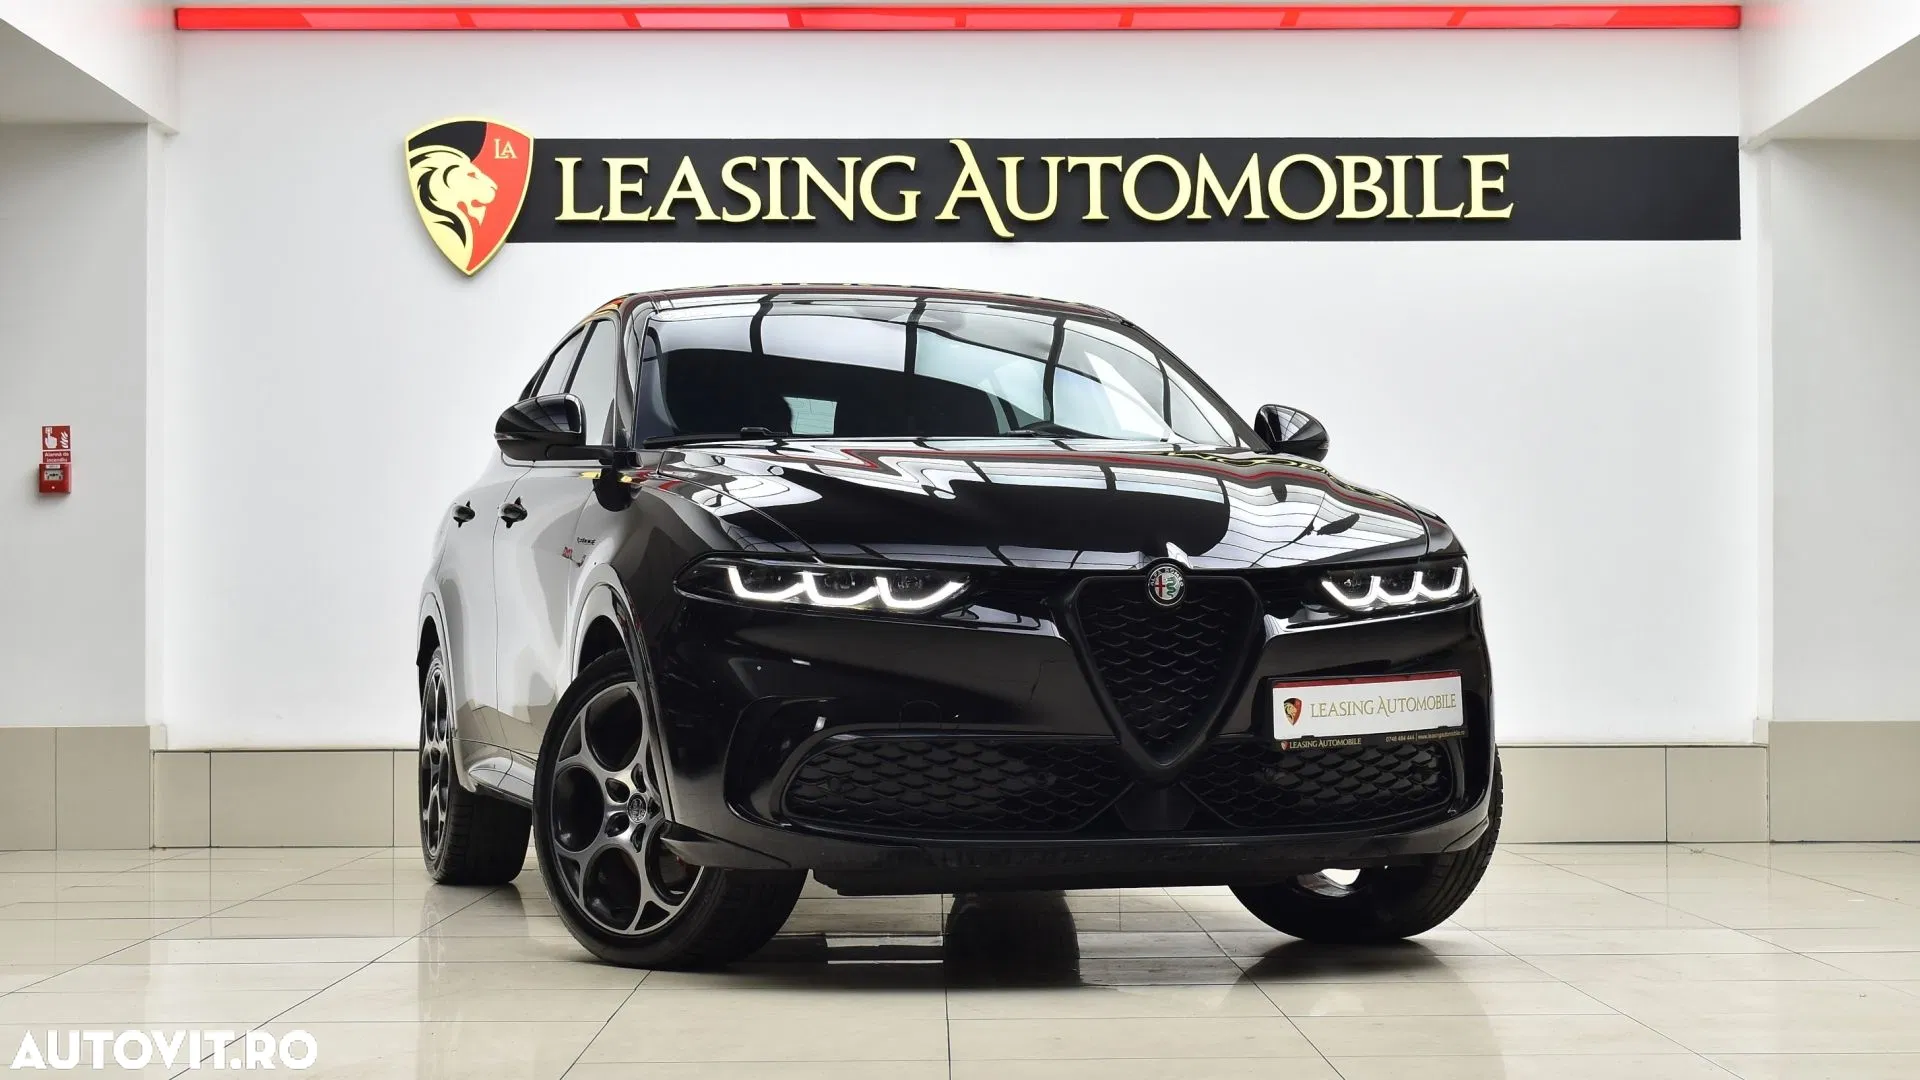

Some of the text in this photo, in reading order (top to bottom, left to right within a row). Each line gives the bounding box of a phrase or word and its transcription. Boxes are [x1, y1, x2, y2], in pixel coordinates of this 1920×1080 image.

[494, 138, 518, 160] LA
[555, 138, 1515, 238] LEASING AUTOMOBILE
[1150, 568, 1184, 587] ALFA ROMEO
[1310, 693, 1457, 718] LEASING AUTOMOBILE
[1289, 738, 1362, 749] LEASING AUTOMOBILE
